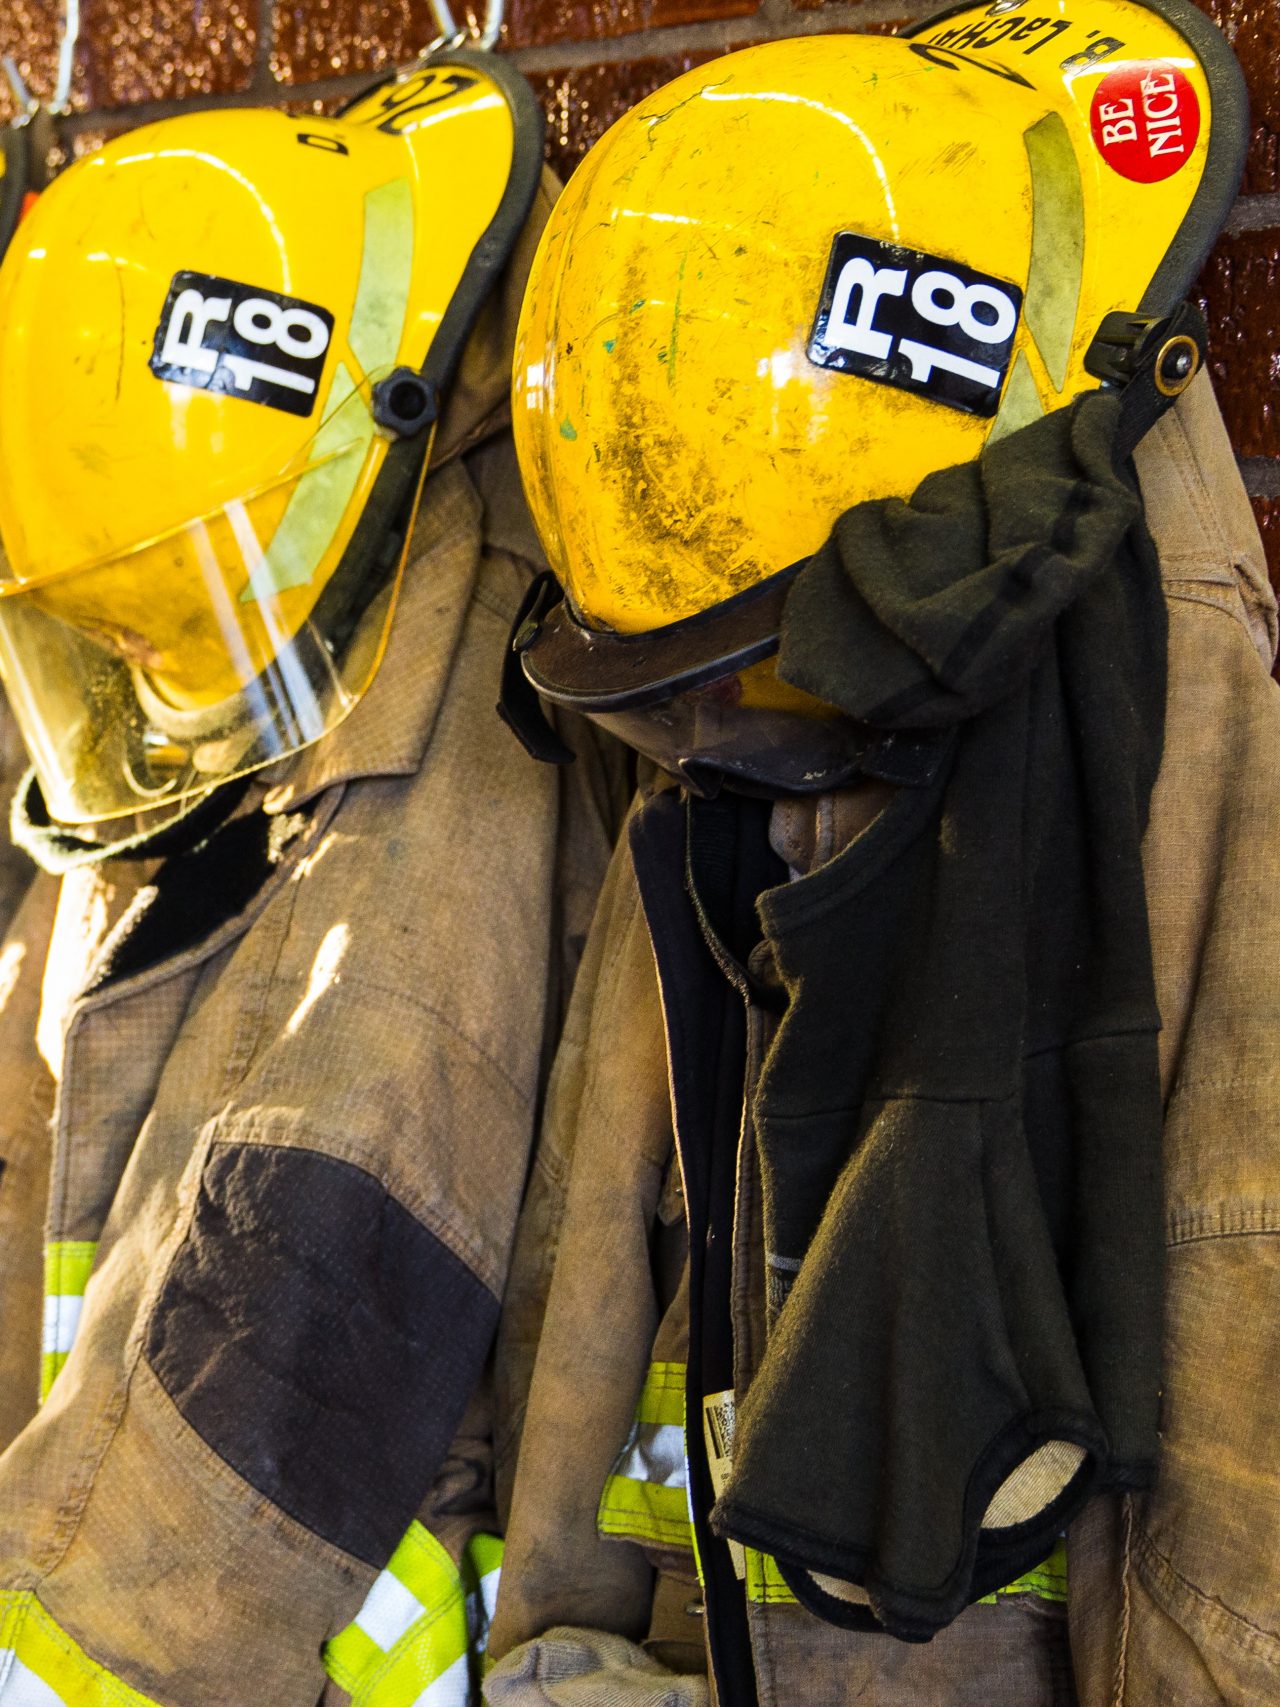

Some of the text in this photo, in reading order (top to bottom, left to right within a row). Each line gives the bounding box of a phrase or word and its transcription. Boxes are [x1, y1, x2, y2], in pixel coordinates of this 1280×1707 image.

[1099, 98, 1137, 146] BE
[1140, 73, 1184, 157] NICE
[161, 288, 232, 371] R
[222, 298, 329, 394] 18
[825, 257, 908, 360] R
[898, 271, 1017, 389] 18
